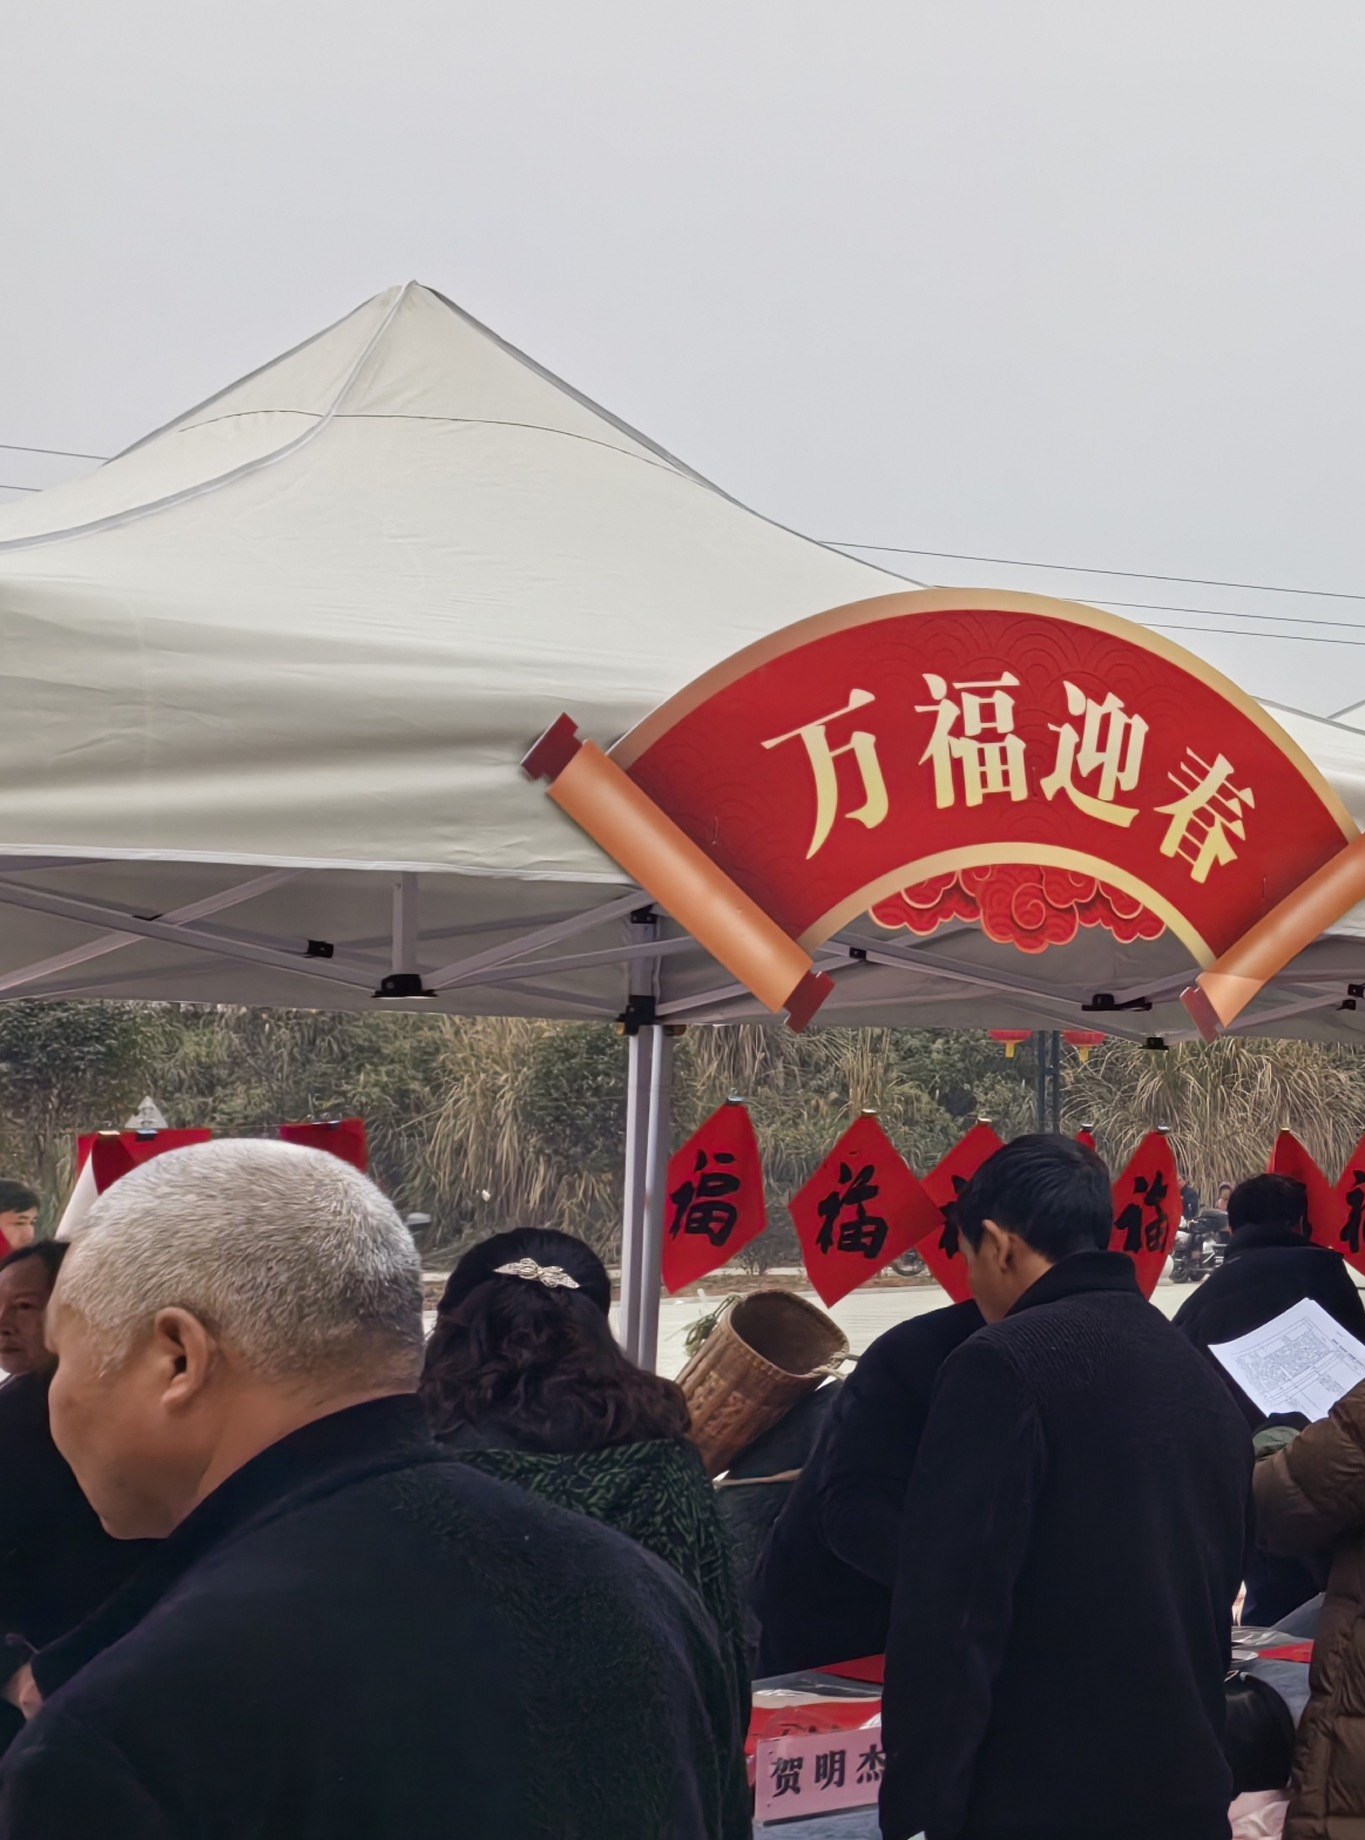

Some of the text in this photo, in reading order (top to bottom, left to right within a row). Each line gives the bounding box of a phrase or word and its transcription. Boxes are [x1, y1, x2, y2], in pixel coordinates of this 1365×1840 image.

[760, 671, 1256, 884] 万福迎春
[668, 1148, 741, 1247] 福
[815, 1161, 890, 1260] 福
[770, 1743, 884, 1798] 贺明杰
